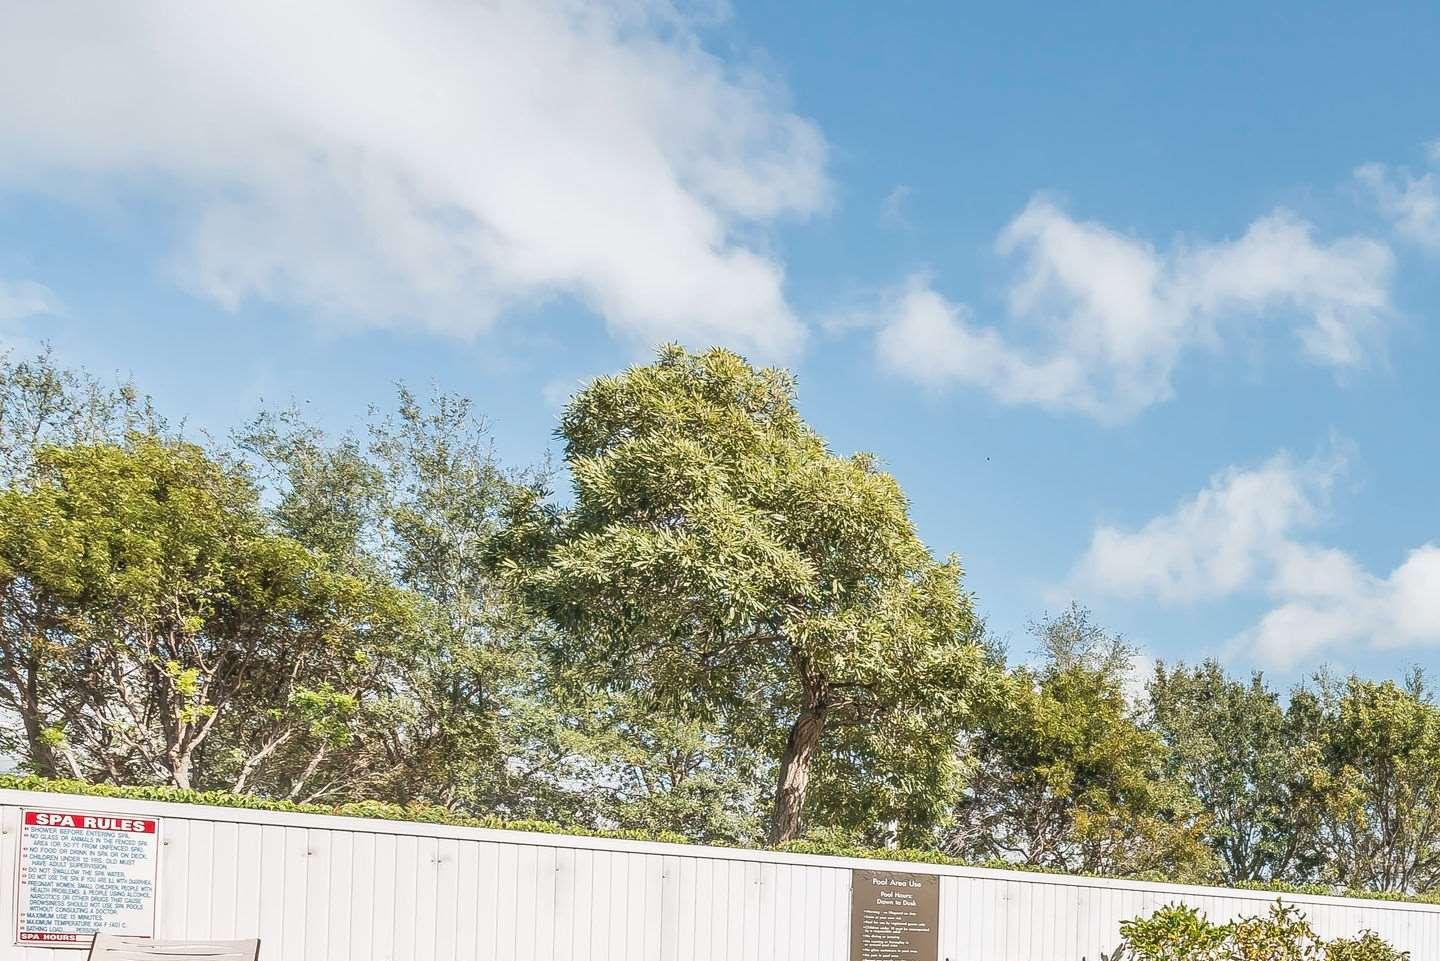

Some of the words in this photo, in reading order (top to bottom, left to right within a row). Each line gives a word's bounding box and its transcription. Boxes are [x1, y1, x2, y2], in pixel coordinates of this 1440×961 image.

[36, 813, 76, 827] SPA
[83, 816, 145, 833] RULES
[872, 878, 888, 886] Pool
[890, 880, 906, 888] Area
[908, 880, 922, 888] Use
